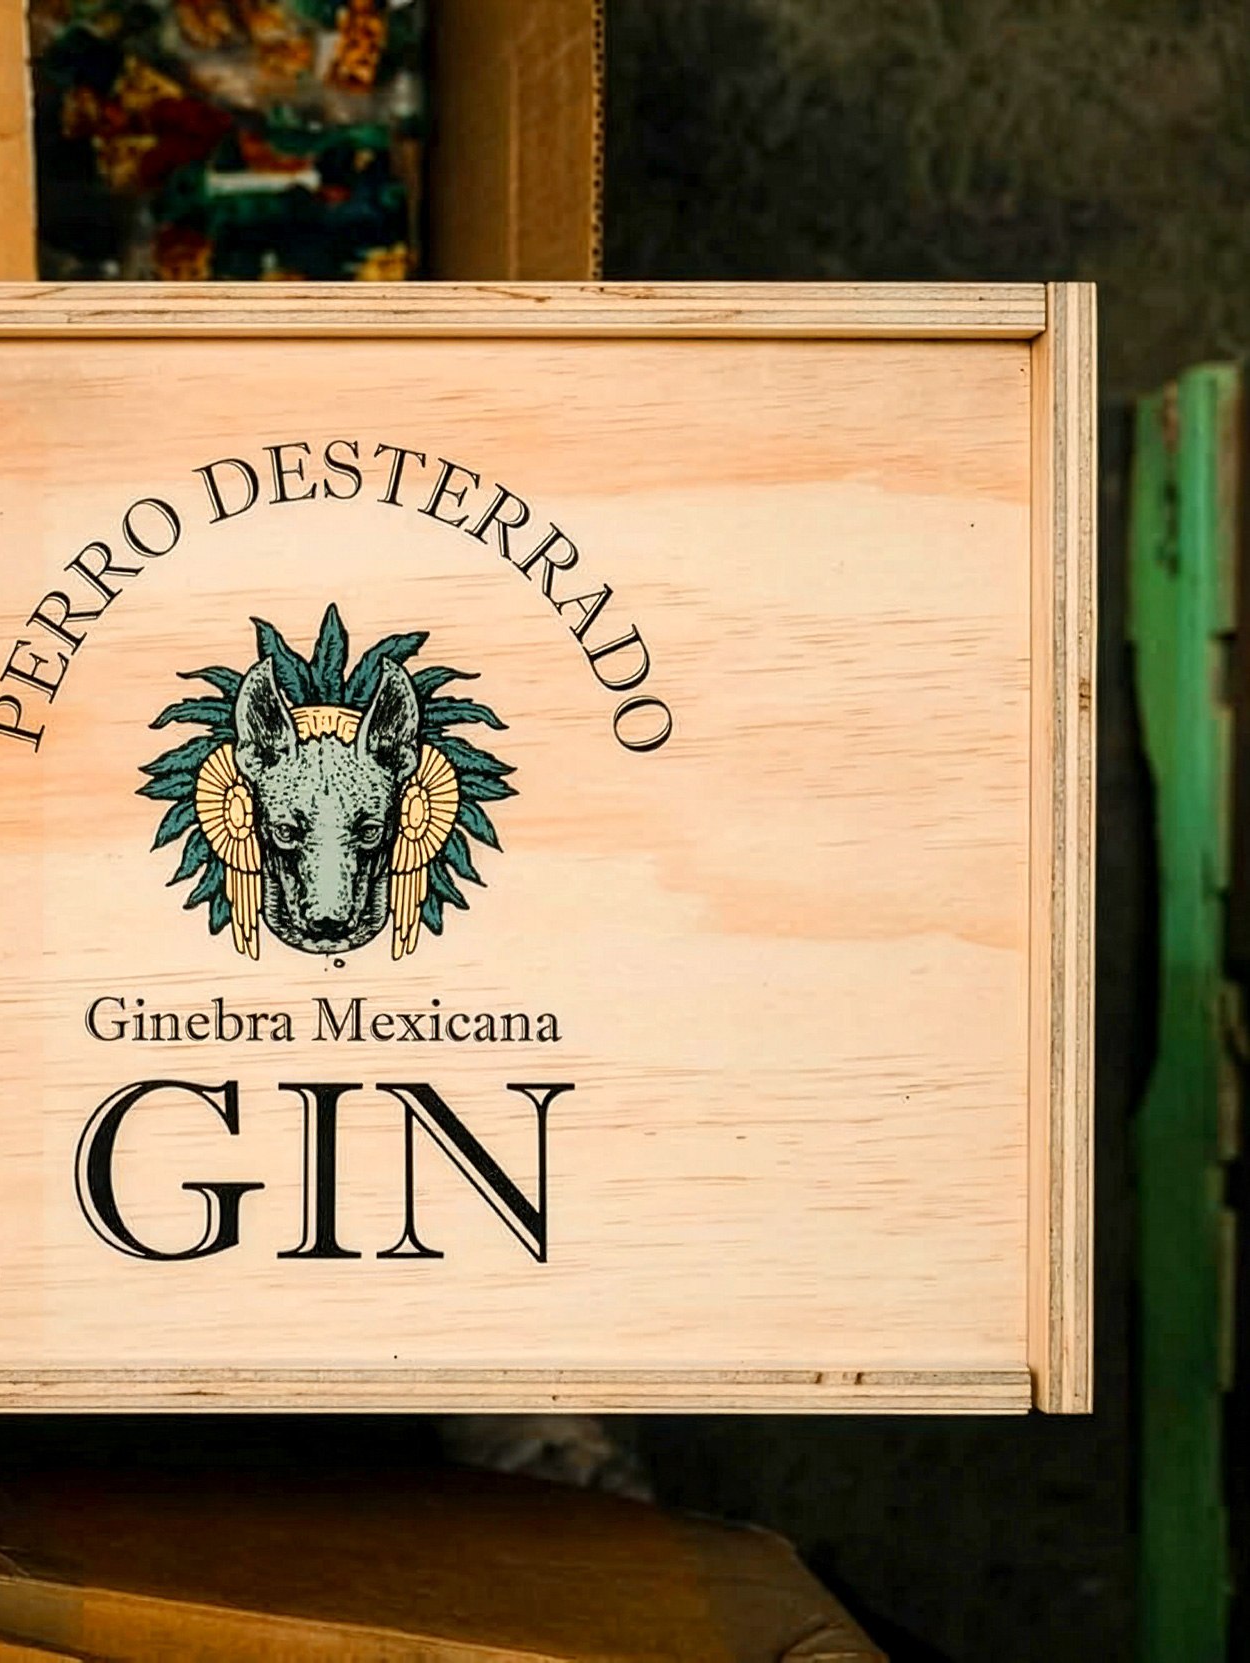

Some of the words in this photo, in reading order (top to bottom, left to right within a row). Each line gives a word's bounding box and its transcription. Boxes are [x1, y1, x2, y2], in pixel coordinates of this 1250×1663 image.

[191, 440, 674, 753] DESTERRADO
[84, 996, 296, 1042] Ginebra
[311, 997, 563, 1043] Mexicana
[75, 1080, 576, 1263] GIN
